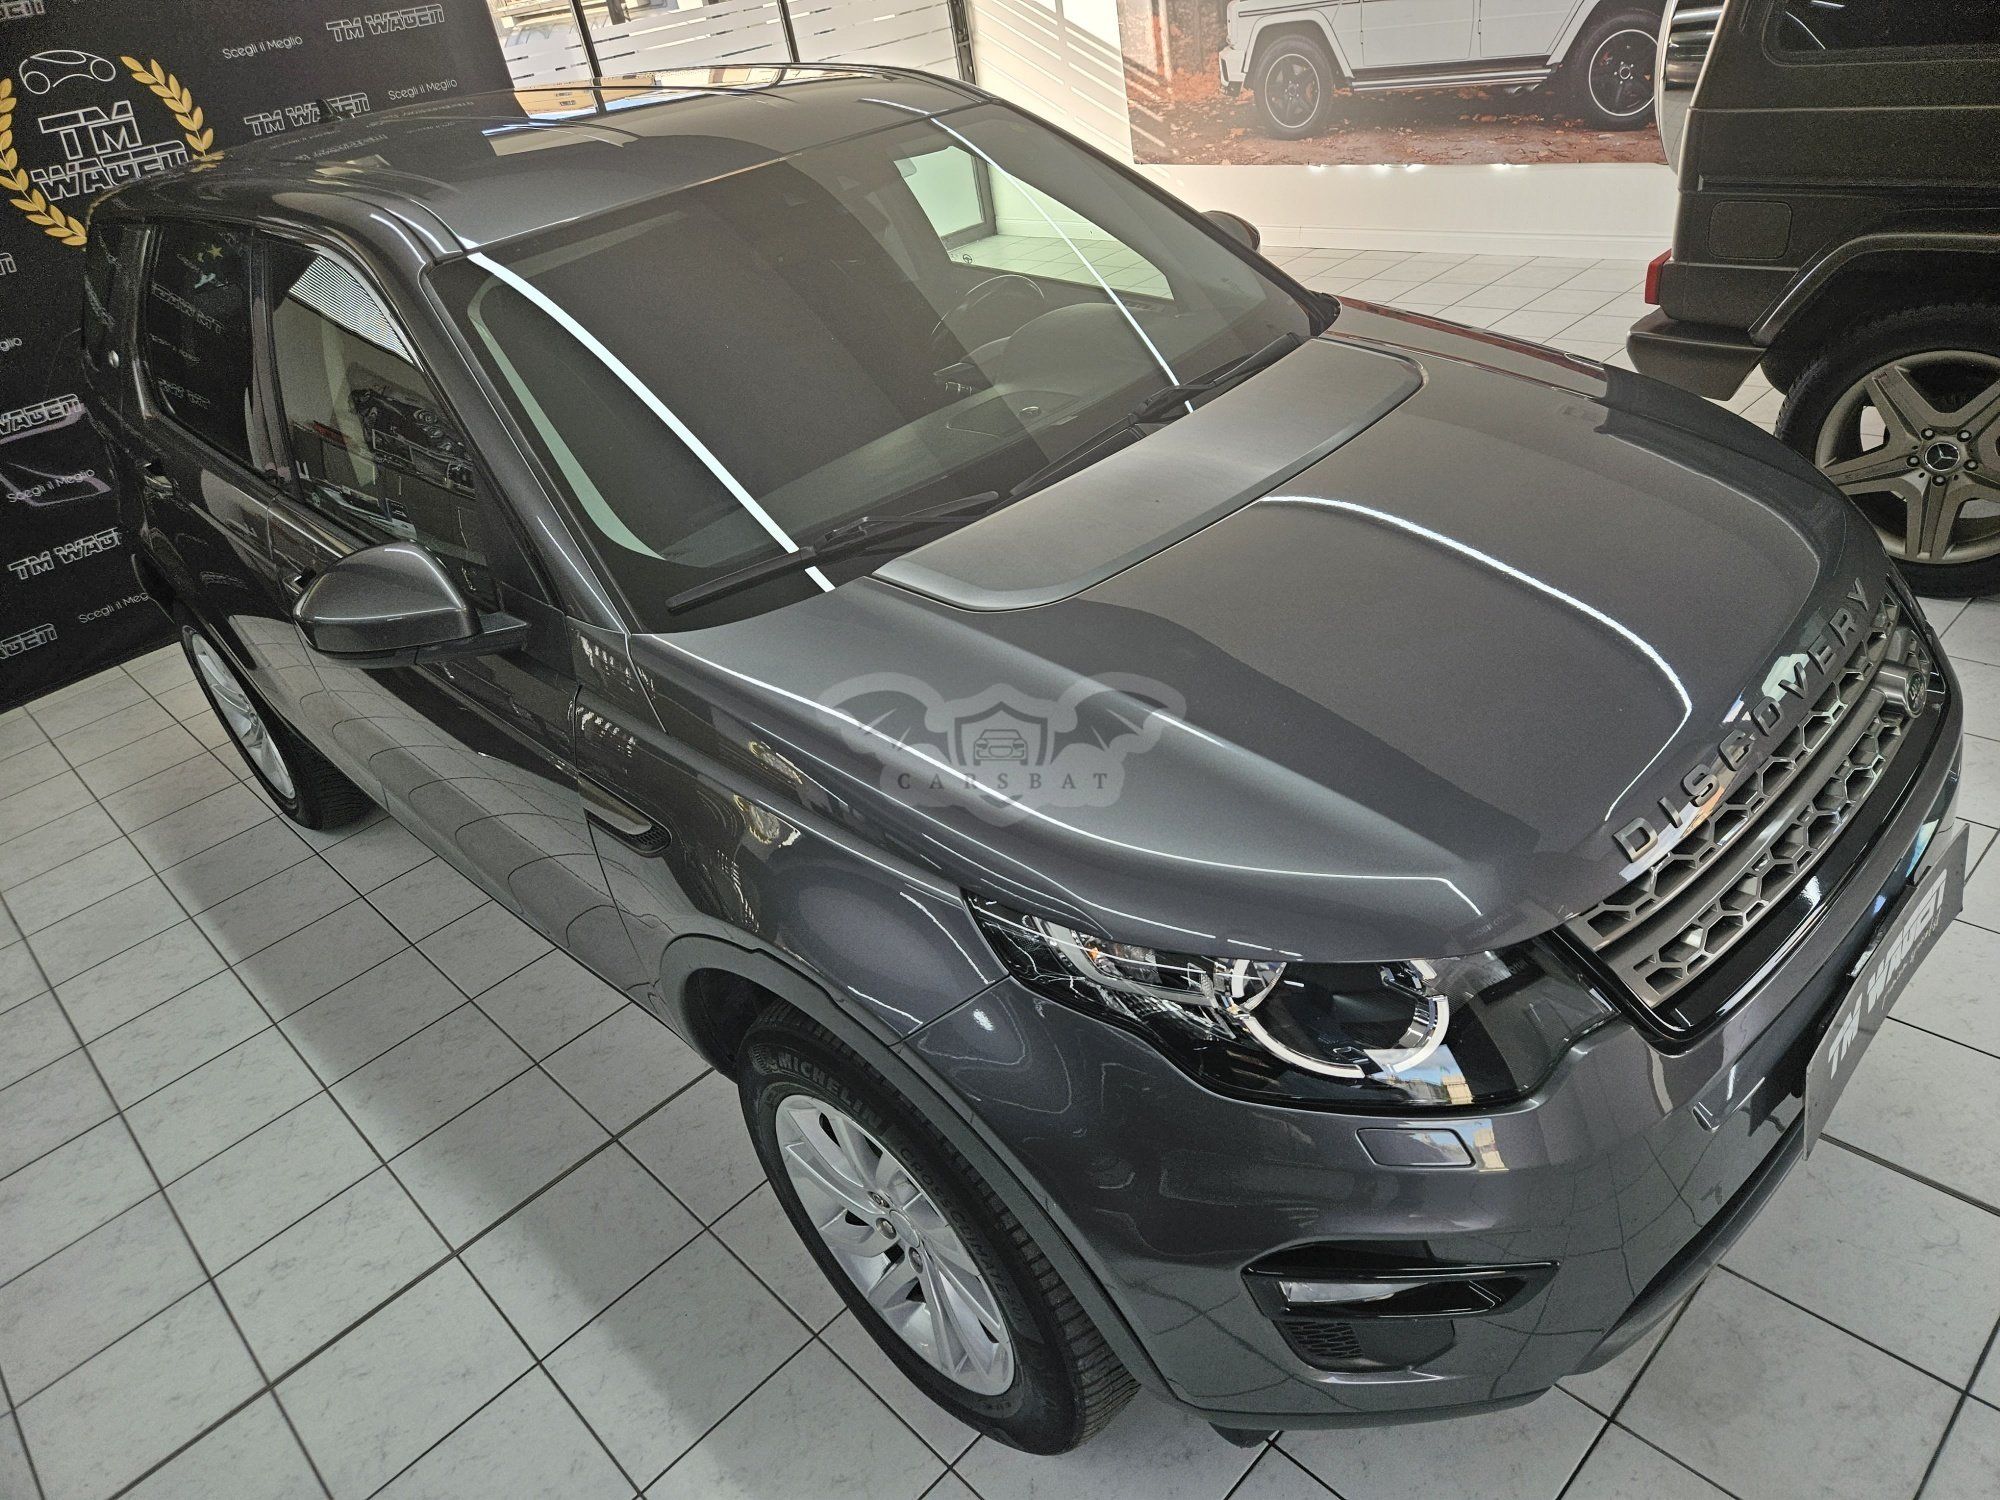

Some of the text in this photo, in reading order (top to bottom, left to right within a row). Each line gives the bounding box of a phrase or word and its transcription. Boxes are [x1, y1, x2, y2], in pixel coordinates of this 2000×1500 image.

[326, 17, 364, 42] TM
[222, 43, 258, 59] Scegli
[268, 35, 303, 50] Meglio
[388, 87, 418, 101] Scegli
[426, 79, 458, 92] Meglio
[37, 100, 142, 160] TM
[244, 110, 285, 136] TM
[7, 551, 54, 580] TM
[78, 605, 115, 623] Scegli
[123, 592, 149, 607] Meg
[1611, 577, 1869, 863] DISCOVERY
[1828, 992, 1863, 1080] TM
[777, 1051, 884, 1130] MICHELIN
